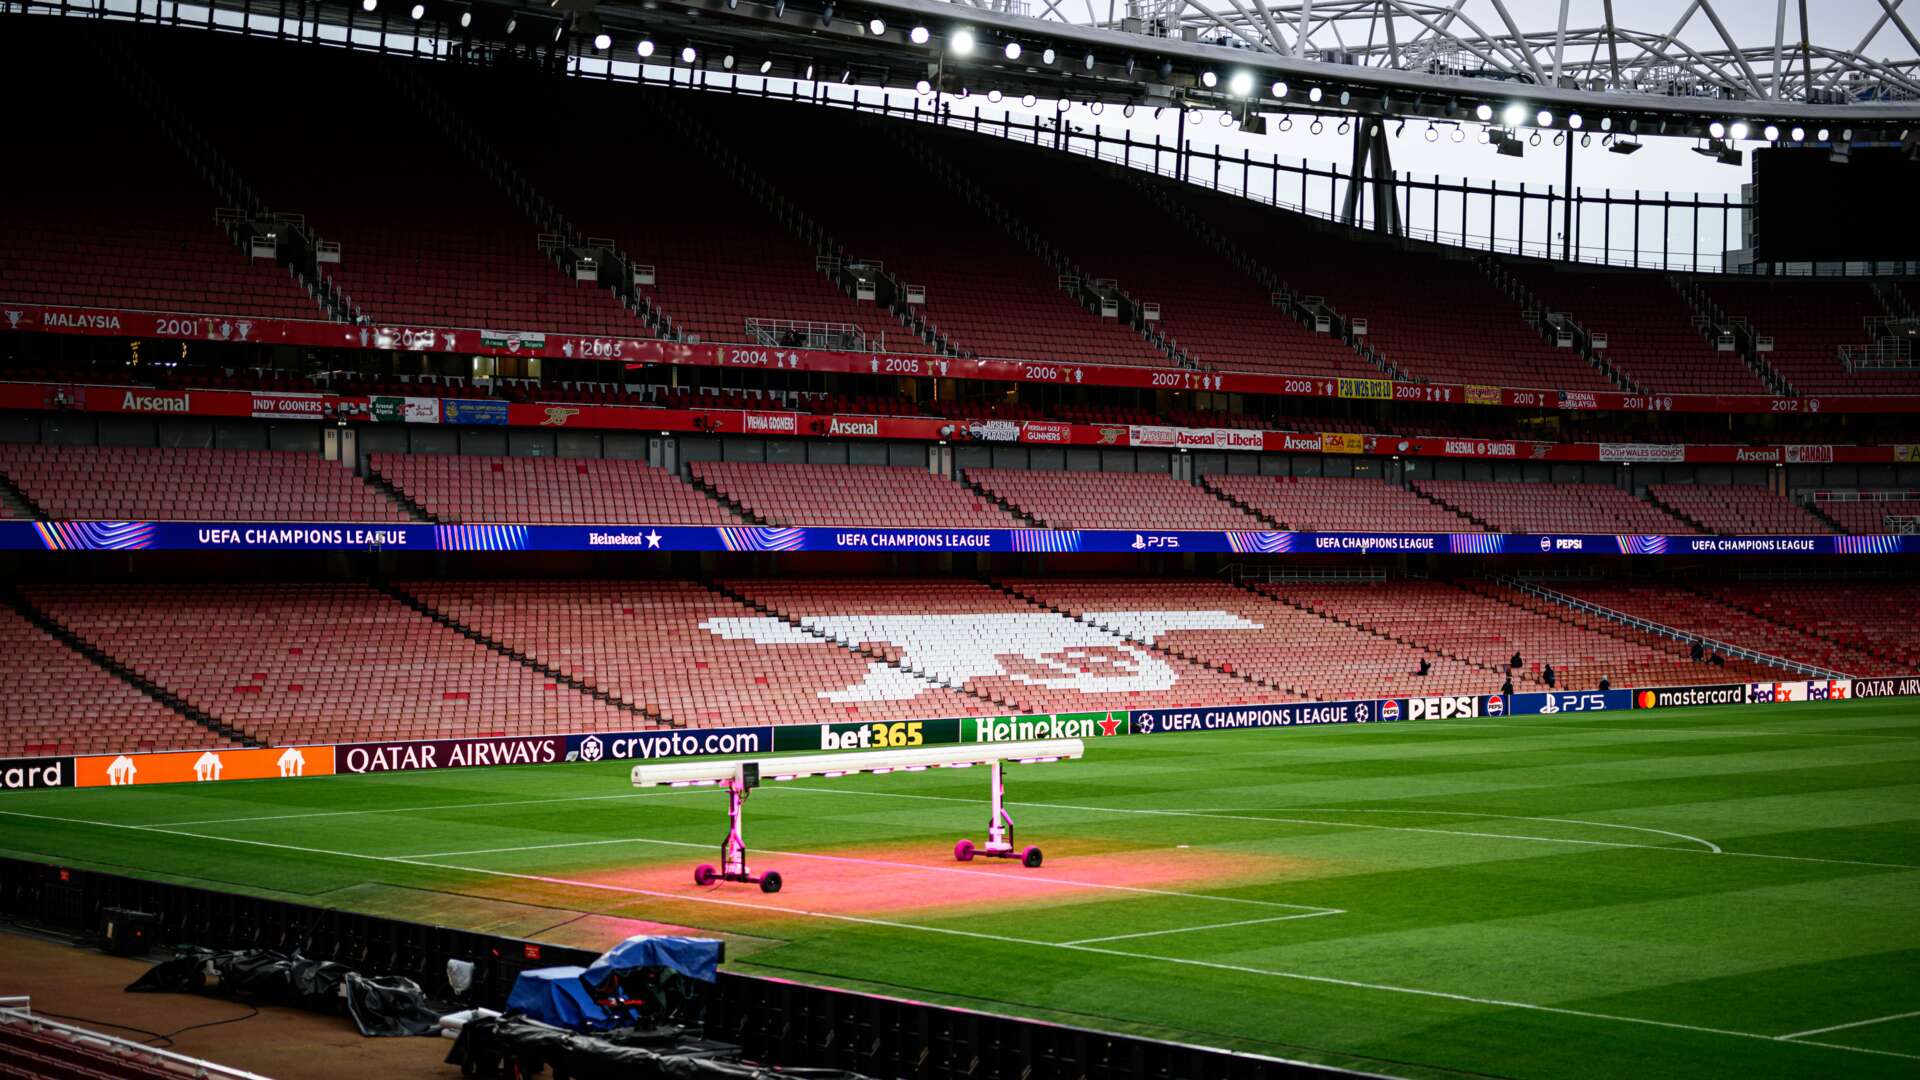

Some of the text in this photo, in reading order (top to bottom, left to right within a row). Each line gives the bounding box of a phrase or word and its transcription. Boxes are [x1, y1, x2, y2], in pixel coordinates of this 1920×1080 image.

[44, 312, 120, 329] MALAYSIA
[156, 319, 198, 336] 2001
[584, 342, 622, 357] 2003
[732, 350, 768, 365] 2004
[886, 358, 919, 373] 2005
[1026, 366, 1057, 380] 2006
[1152, 373, 1180, 386] 2007
[1284, 380, 1312, 393] 2008
[1396, 386, 1421, 398] 2009
[1513, 393, 1535, 404] 2010
[122, 391, 190, 412] Arsenal
[253, 399, 322, 412] INDY GOONERS
[1623, 397, 1644, 408] 2011
[1771, 400, 1798, 412] 2012
[829, 418, 878, 435] Arsenal
[1027, 432, 1061, 441] GUNNERS
[1176, 431, 1215, 445] Arsenal
[1226, 432, 1262, 447] Liberia
[1284, 435, 1321, 450] Arsenal
[1445, 441, 1516, 455] ARSENAL SWEDEN
[1601, 448, 1625, 456] SOUTH
[1626, 449, 1650, 457] WALES
[1736, 448, 1779, 461] Arsenal
[198, 529, 407, 545] UEFA CHAMPIONS LEAGUE
[589, 532, 642, 545] Heineken
[836, 533, 991, 547] UEFA CHAMPIONS LEAGUE
[1147, 536, 1179, 547] PS5
[1316, 537, 1434, 550] UEFA CHAMPIONS LEAGUE
[1556, 539, 1583, 550] PEPSI
[1691, 540, 1815, 551] UEFA CHAMPIONS LEAGUE
[1659, 686, 1742, 706] mastercard
[1751, 683, 1792, 703] FedEx
[1807, 680, 1846, 700] FedEx
[1855, 680, 1894, 698] QATAR
[1408, 697, 1479, 720] PEPSI
[1563, 694, 1606, 711] PS5
[1162, 707, 1348, 731] UEFA CHAMPIONS LEAGUE
[975, 714, 1096, 742] Heineken
[821, 722, 923, 750] bet365
[611, 732, 759, 759] crypto.com
[346, 740, 556, 773] QATAR AIRWAYS
[0, 762, 62, 788] ard
